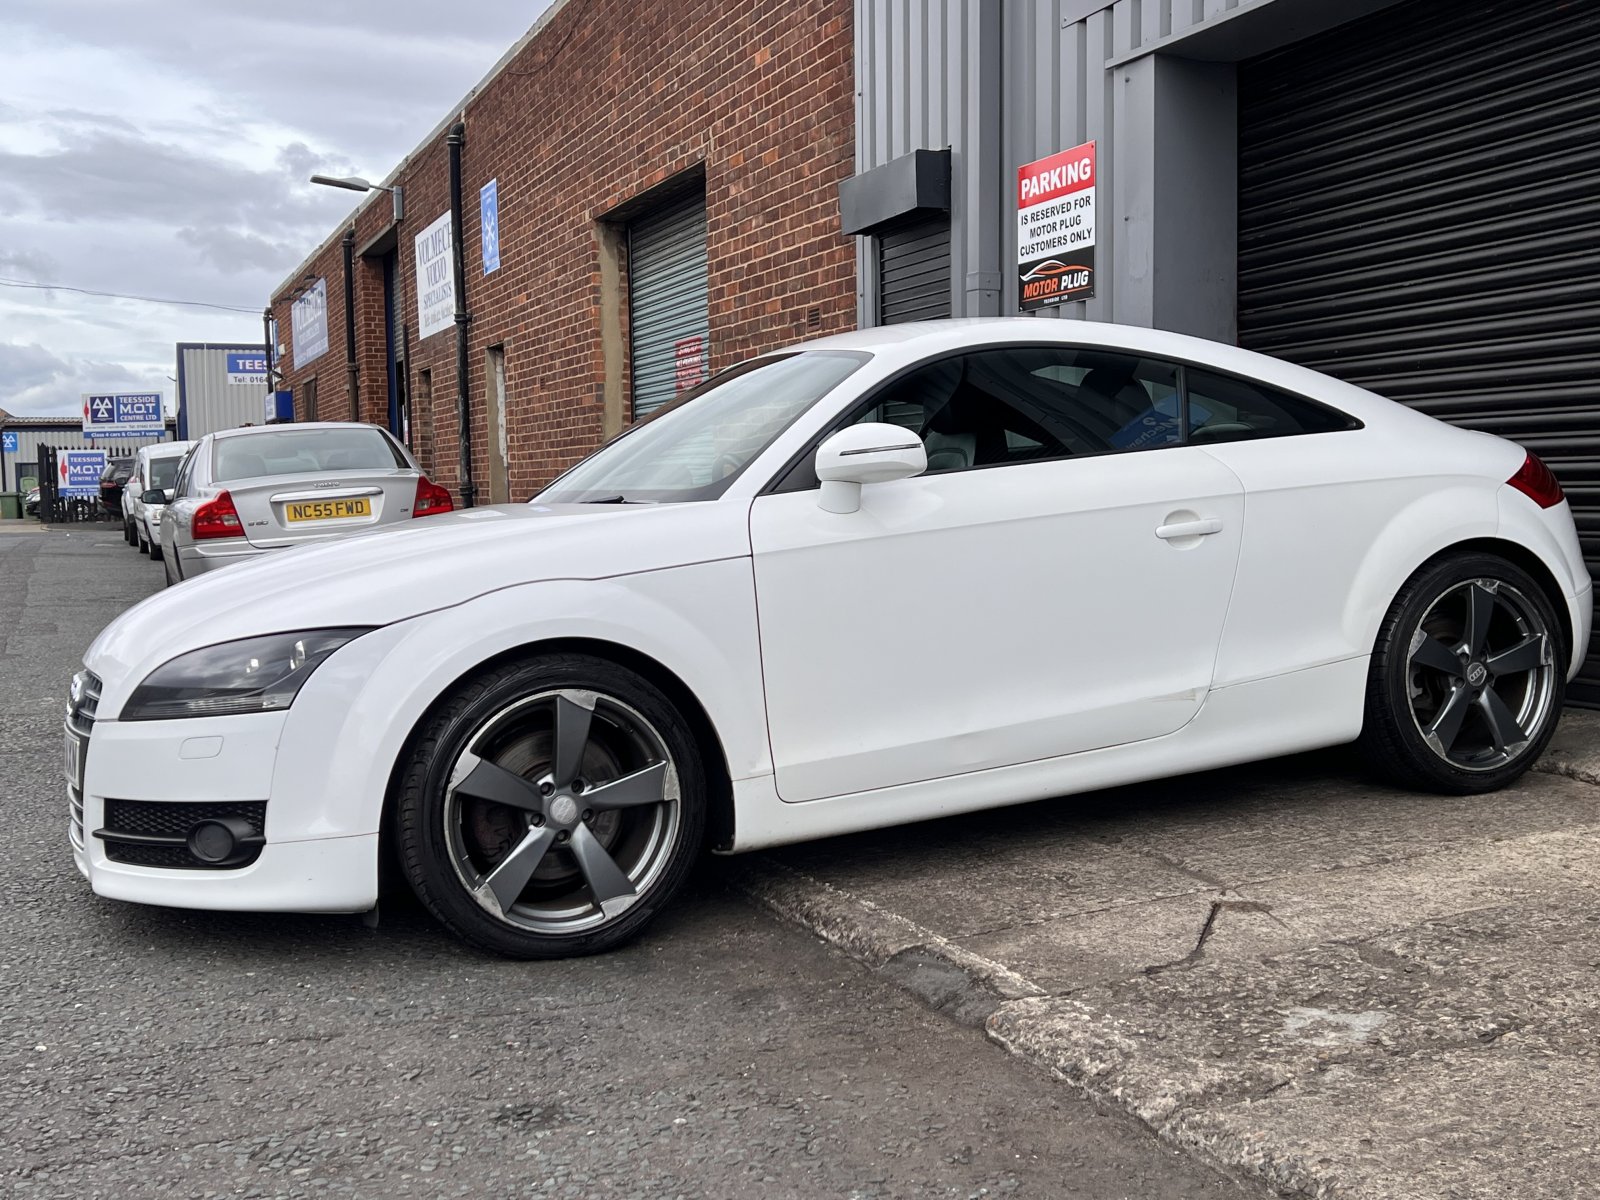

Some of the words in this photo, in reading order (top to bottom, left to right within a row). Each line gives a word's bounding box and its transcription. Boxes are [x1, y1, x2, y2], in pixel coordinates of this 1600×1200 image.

[1021, 157, 1091, 200] PARKING
[1021, 214, 1029, 226] IS
[1030, 201, 1072, 223] RESERVED
[1074, 195, 1091, 211] FOR
[1030, 221, 1058, 239] MOTOR
[1059, 214, 1082, 231] PLUG
[418, 221, 452, 266] VOLMECH
[1020, 234, 1068, 256] CUSTOMERS
[1070, 227, 1092, 243] ONLY
[426, 256, 447, 287] VOLVO
[1024, 278, 1059, 298] MOTOR
[1060, 270, 1089, 290] PLUG
[424, 281, 452, 310] SPECIALISTS
[119, 395, 156, 403] TEESSIDE
[120, 403, 156, 414] M.O.T
[70, 465, 103, 474] M.O.T
[293, 503, 334, 519] NC55
[335, 501, 364, 516] FWD
